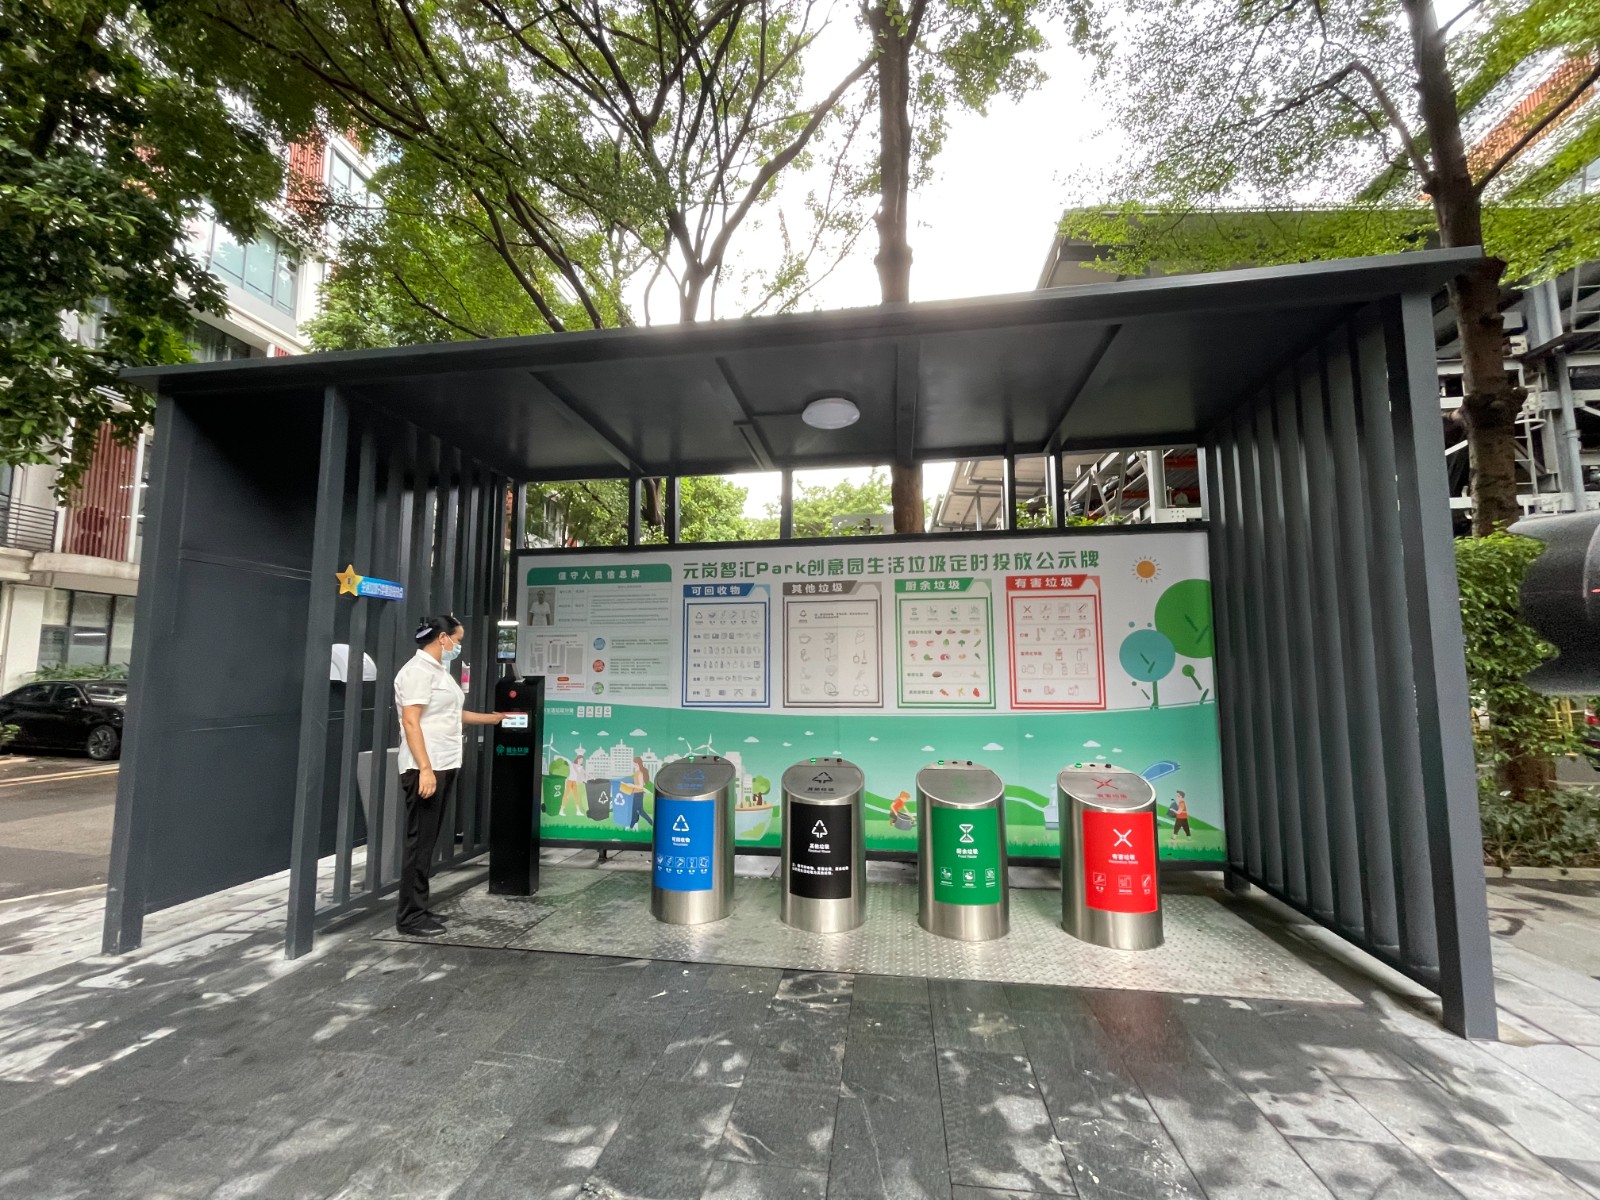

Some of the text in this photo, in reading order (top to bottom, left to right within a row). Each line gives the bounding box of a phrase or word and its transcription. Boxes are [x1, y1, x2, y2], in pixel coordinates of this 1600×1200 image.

[683, 550, 1100, 580] 元岗智汇Park创意园生活垃圾定时投放公示牌
[558, 569, 640, 581] 值守人员信息牌
[791, 582, 843, 594] 其他垃圾
[905, 579, 960, 591] 厨余垃圾
[1014, 576, 1073, 589] 有害垃圾
[691, 585, 741, 596] 可回收物
